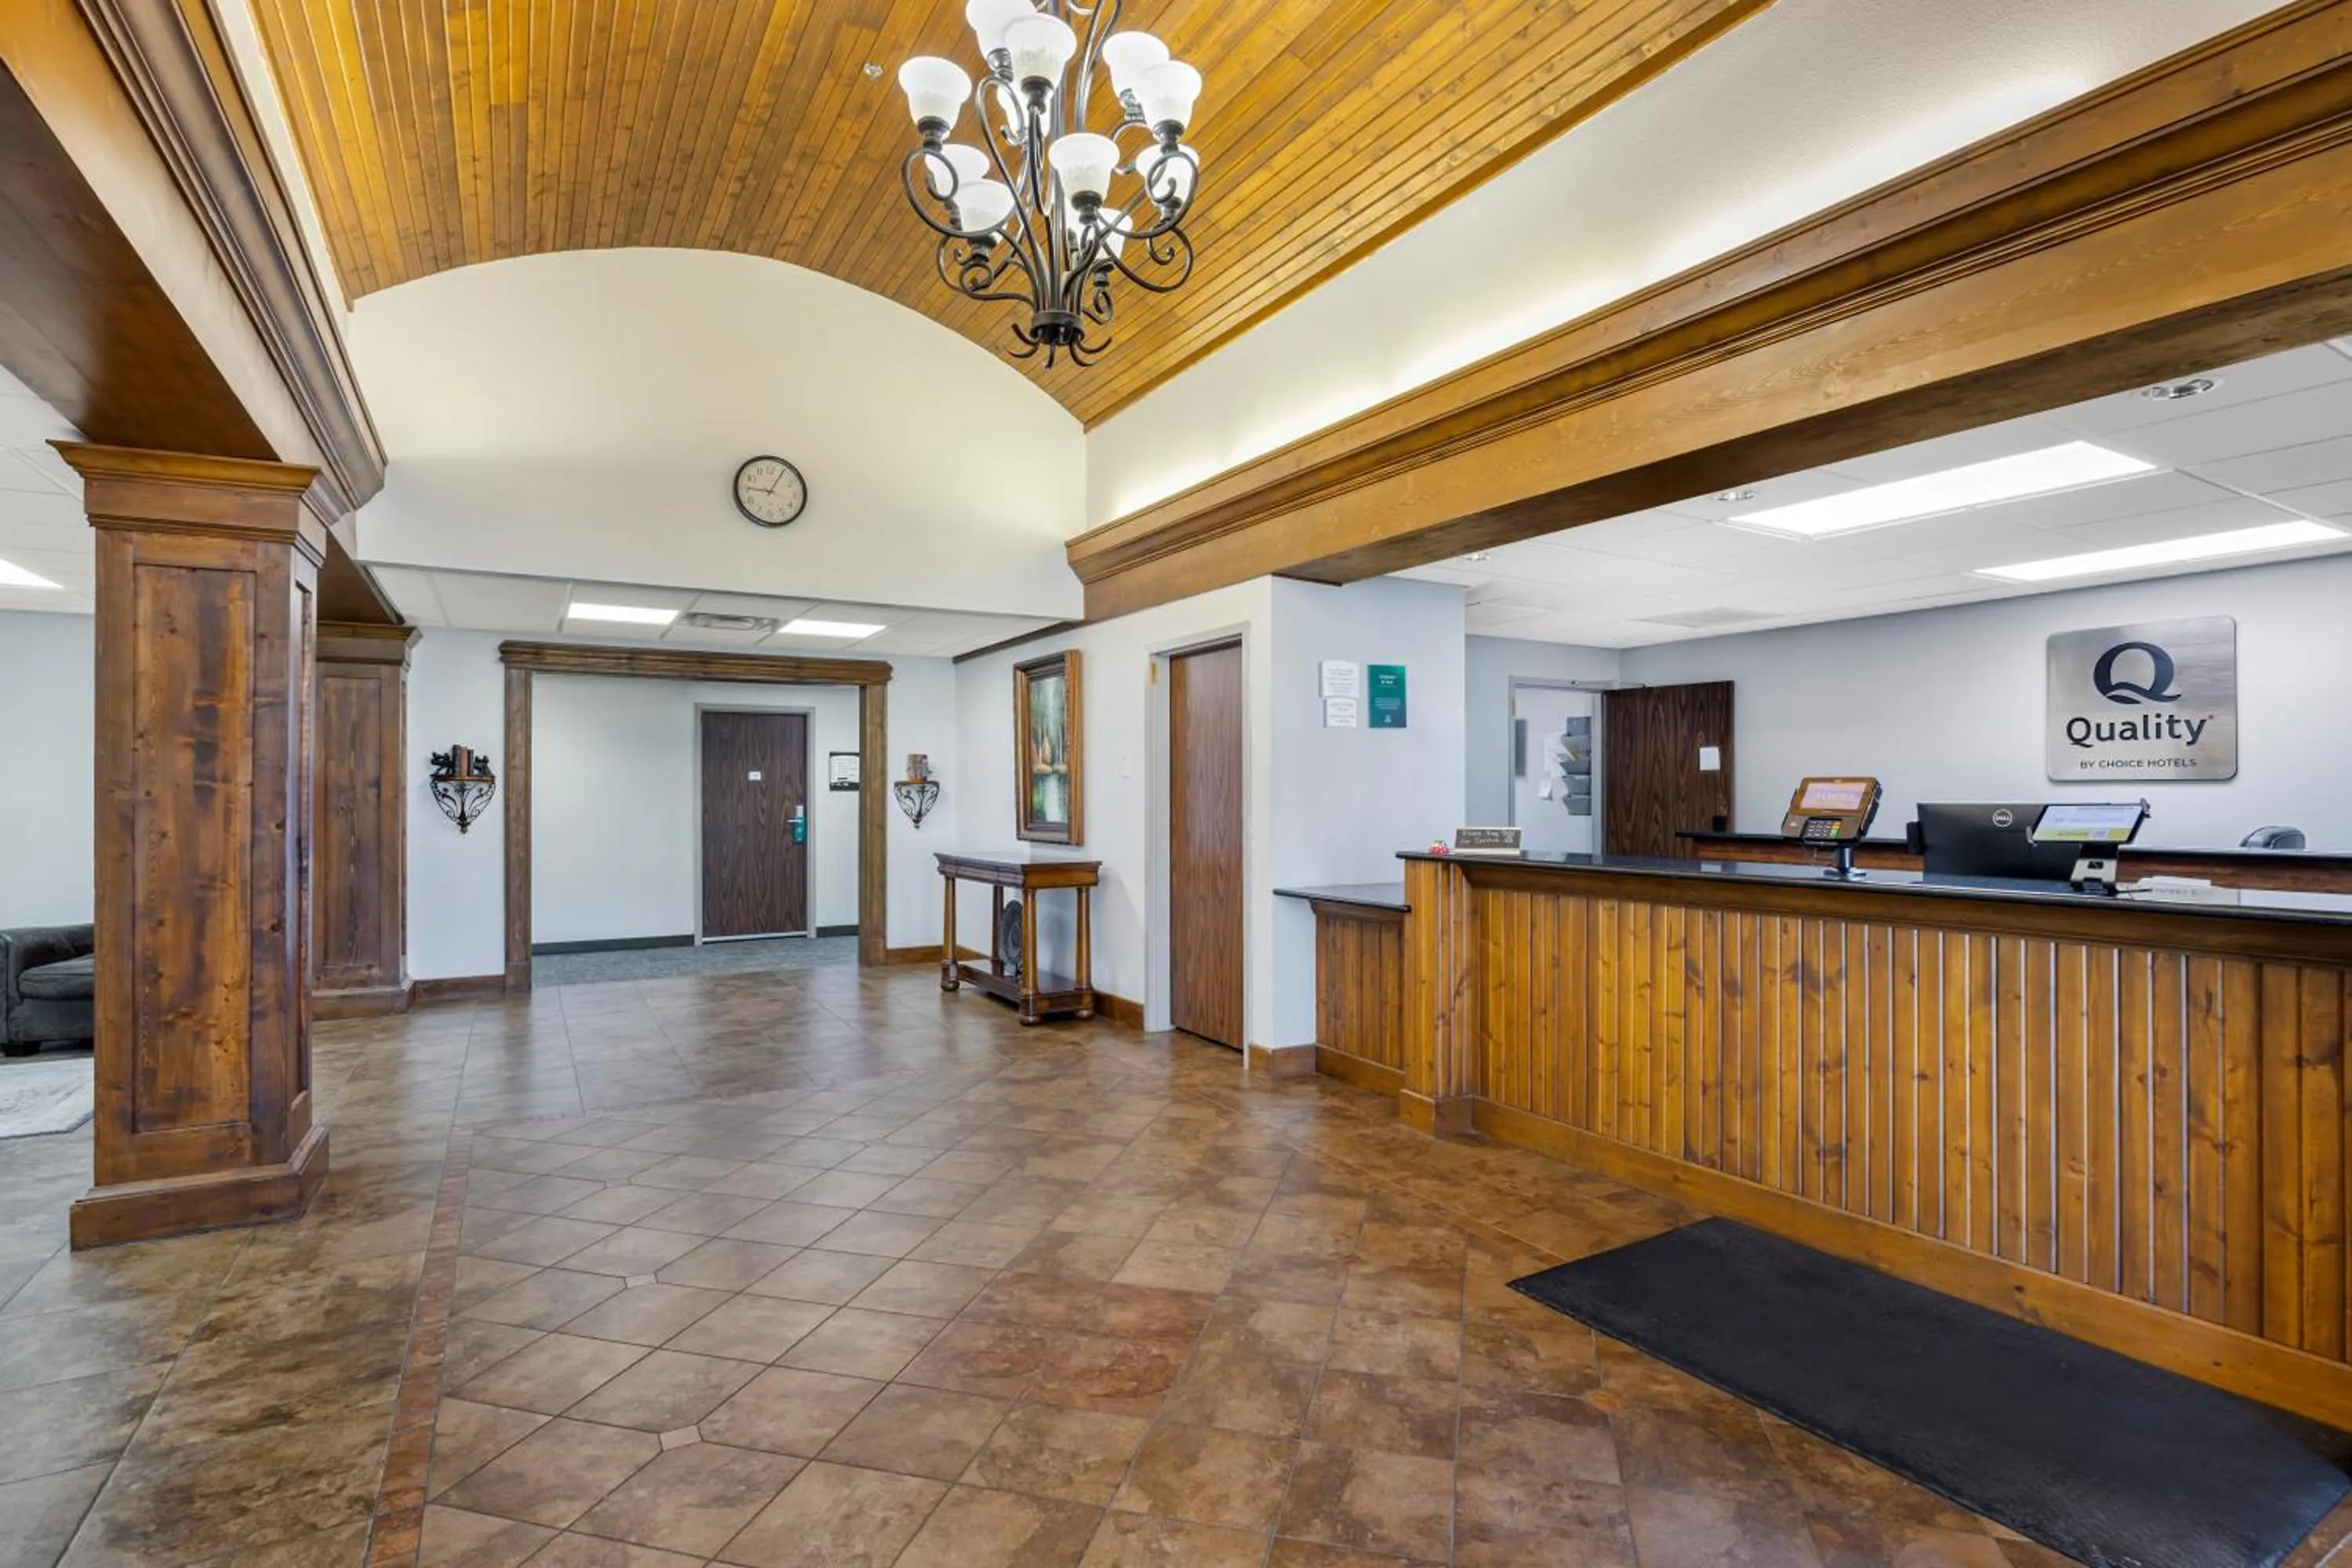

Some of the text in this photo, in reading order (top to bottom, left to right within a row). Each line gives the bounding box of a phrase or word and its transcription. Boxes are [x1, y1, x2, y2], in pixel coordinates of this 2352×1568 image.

[2067, 713, 2207, 748] Quality
[2080, 758, 2197, 769] BY CHOICE HOTELS
